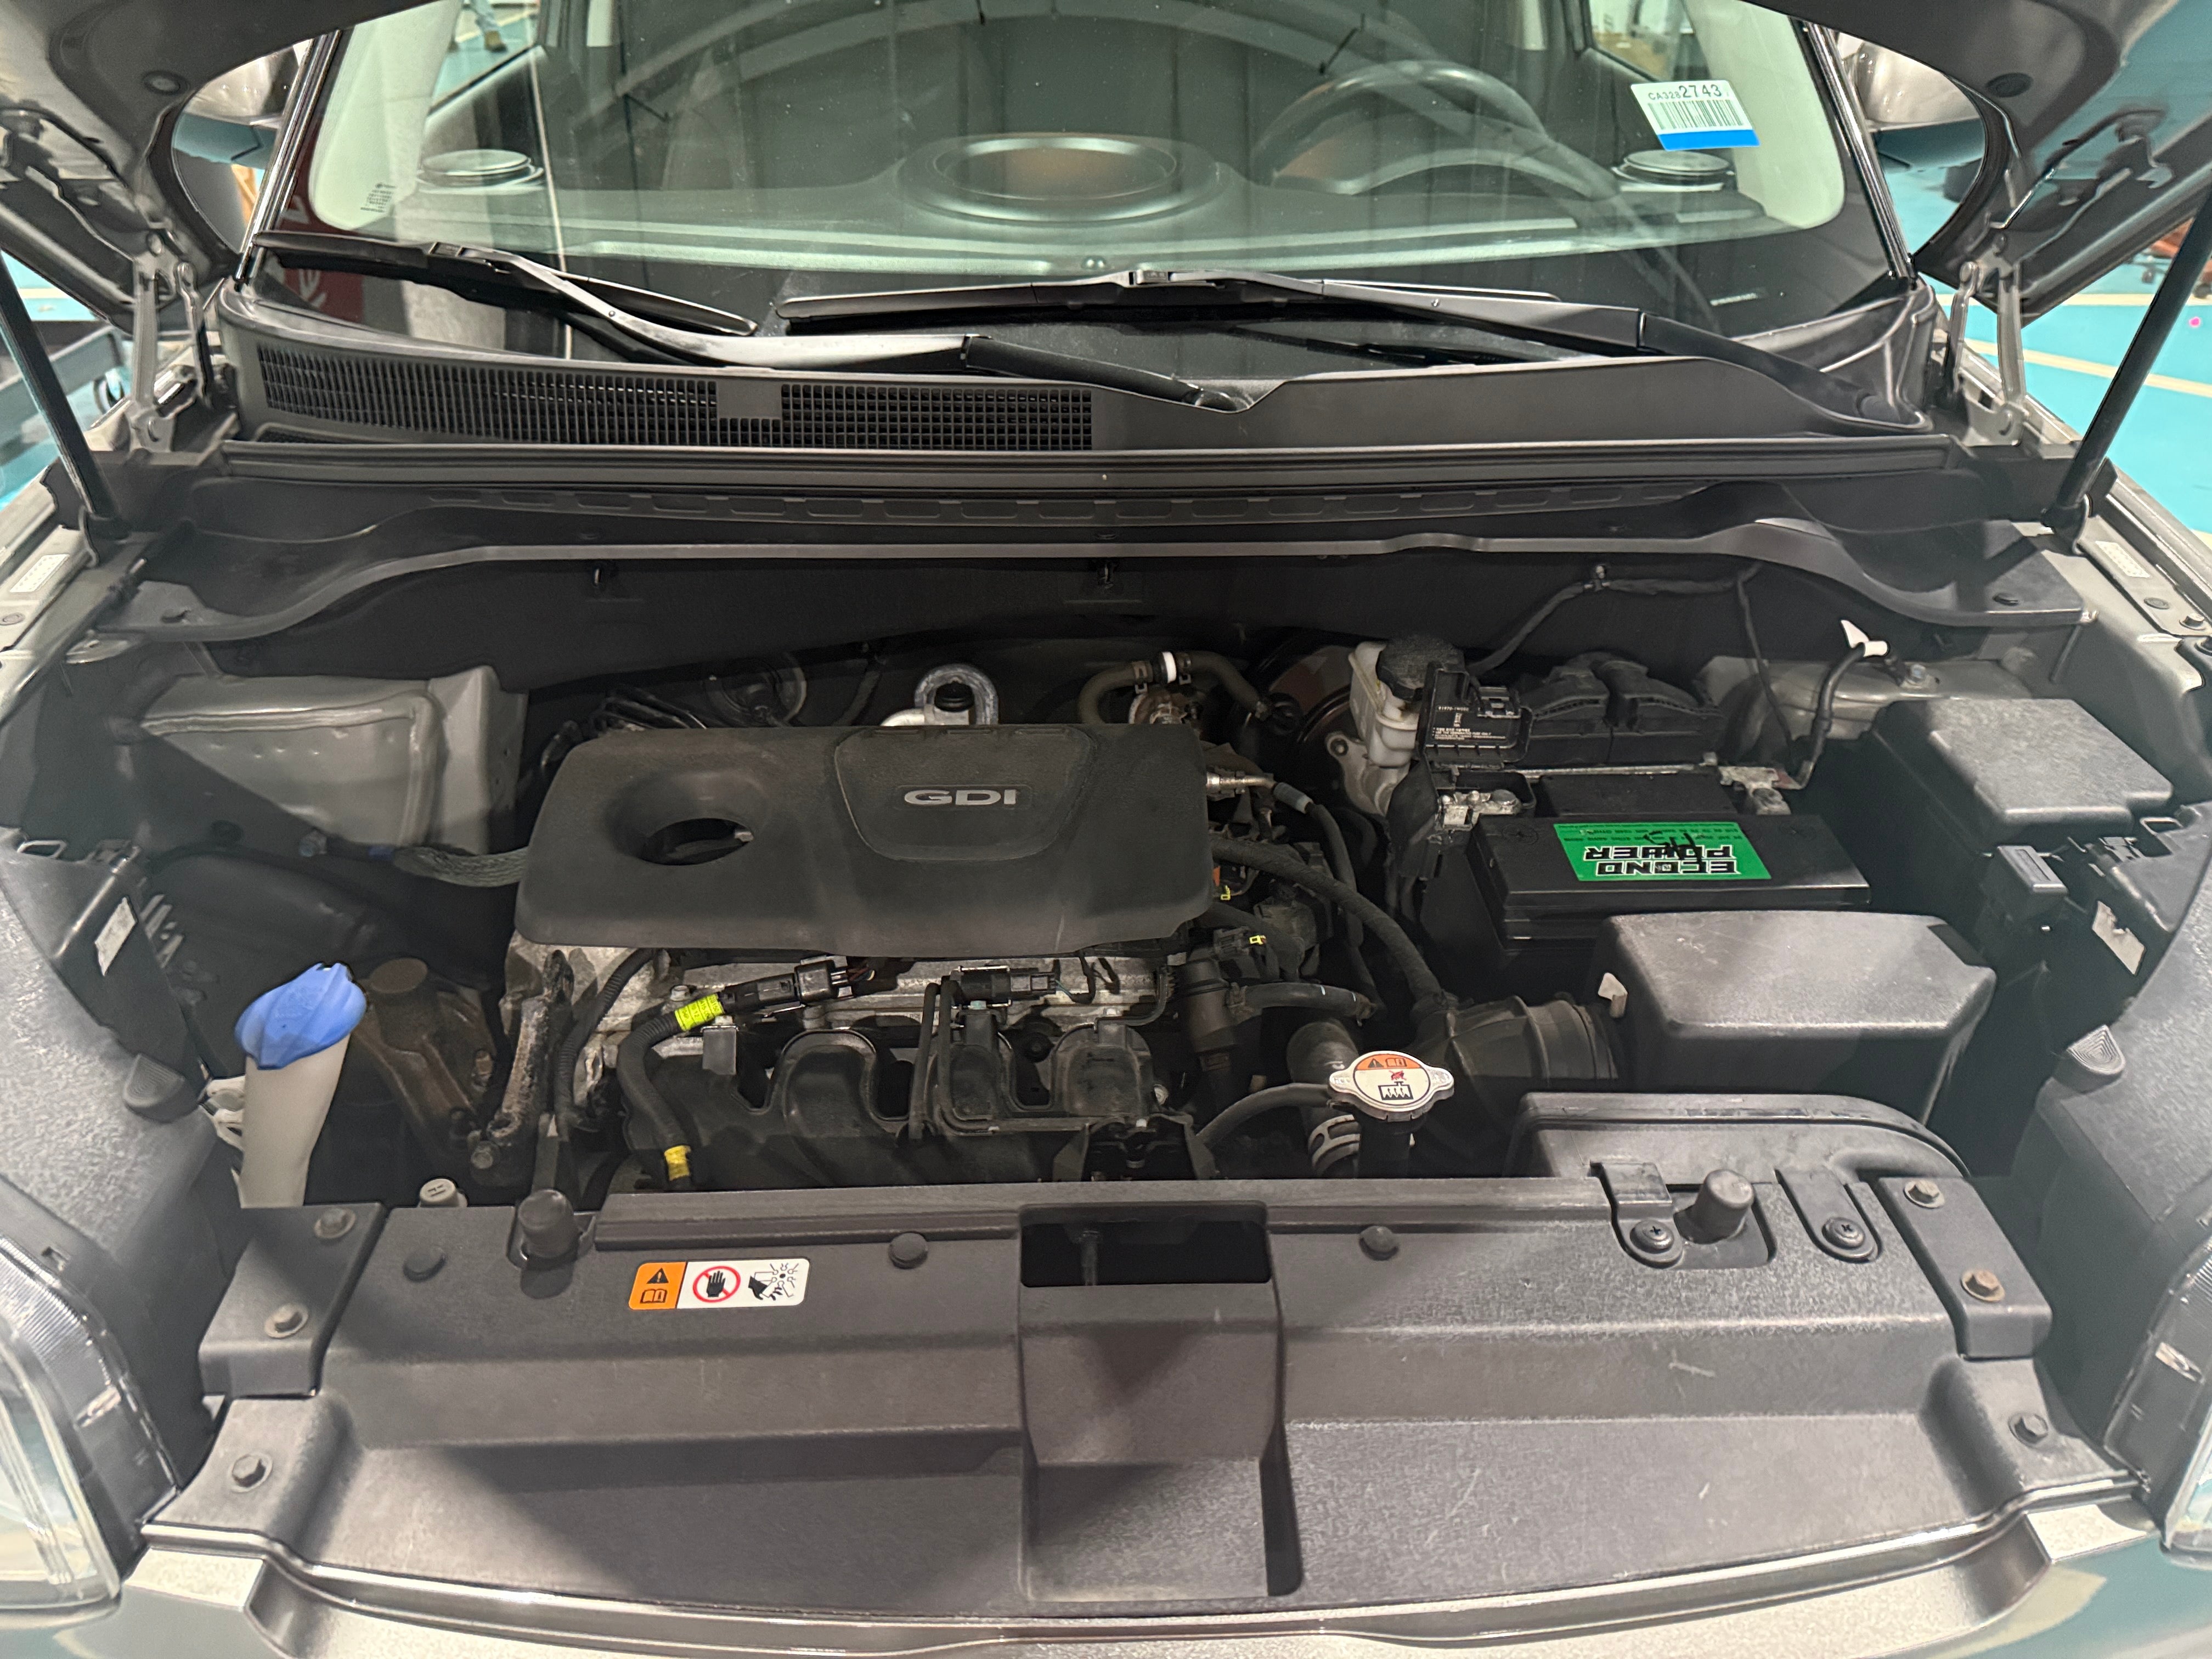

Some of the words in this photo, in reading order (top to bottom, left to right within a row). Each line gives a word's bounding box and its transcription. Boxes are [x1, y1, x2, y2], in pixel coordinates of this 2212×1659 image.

[904, 789, 1017, 805] GDI
[1583, 845, 1736, 861] POWER
[1595, 860, 1741, 876] ECONO
